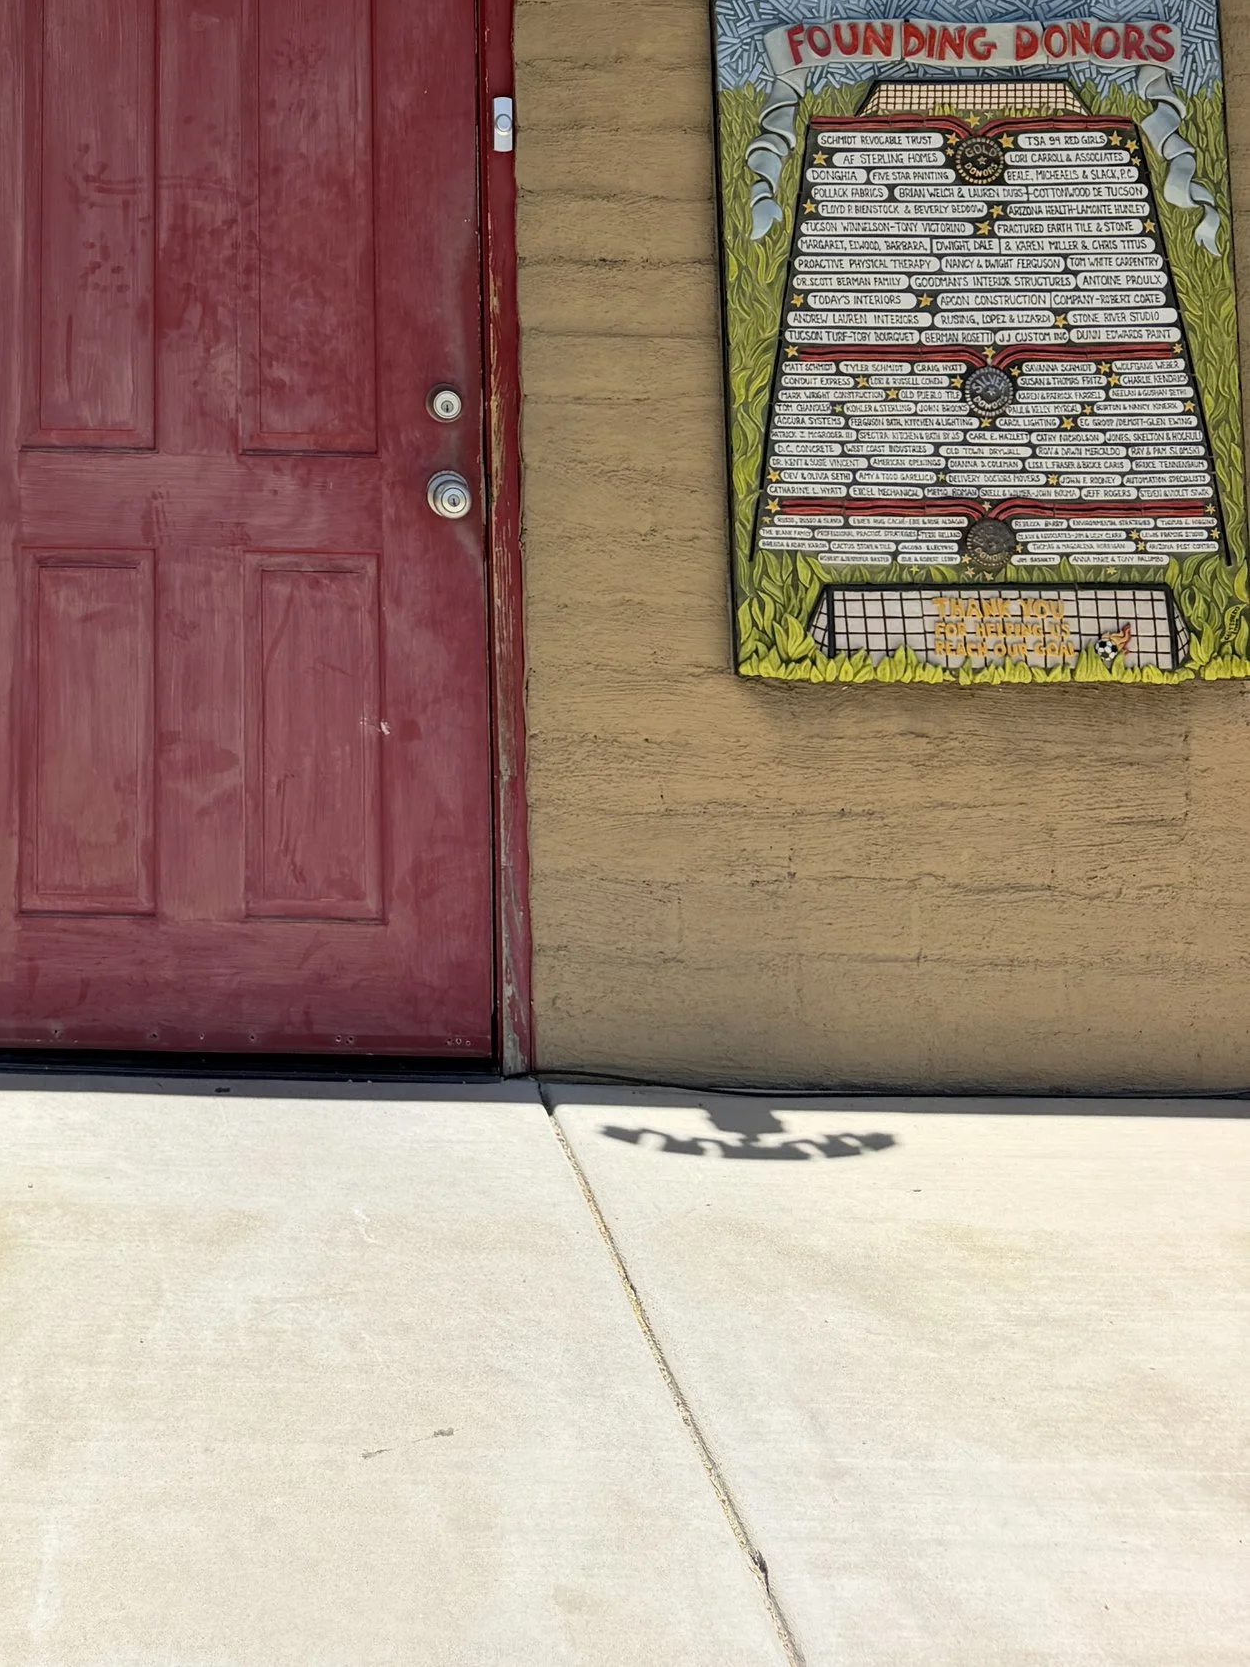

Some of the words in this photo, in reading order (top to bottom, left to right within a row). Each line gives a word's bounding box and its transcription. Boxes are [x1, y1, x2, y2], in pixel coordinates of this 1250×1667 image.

[786, 23, 997, 67] FOUNDING
[1014, 21, 1176, 63] DONORS
[821, 136, 856, 145] SCHMIDT
[861, 136, 902, 144] REVOCABLE
[905, 136, 932, 144] TRUST
[1026, 136, 1046, 145] TSA
[1064, 136, 1079, 144] RED
[1081, 135, 1105, 144] GIRLS
[965, 144, 998, 158] GOLD
[860, 154, 904, 164] STERLING
[908, 153, 938, 163] HOMES
[1010, 154, 1027, 163] LORI
[1031, 154, 1063, 162] CARROLL
[1066, 154, 1072, 162] &
[1074, 153, 1124, 162] ASSOCIATES
[964, 162, 998, 177] DONORS
[812, 171, 857, 181] DONGHIA
[873, 172, 889, 180] FIVE
[892, 172, 911, 180] STAR
[913, 172, 948, 180] PAINTING
[814, 189, 848, 198] POLLACK
[851, 188, 884, 198] FABRICS
[821, 205, 845, 214] FLOYD
[855, 205, 899, 214] BIENSTOCK
[904, 205, 911, 214] &
[914, 205, 948, 213] BEVERLY
[1008, 207, 1042, 215] ARIZONA
[805, 223, 837, 232] TUCSON
[997, 223, 1044, 233] FRACTURED
[1047, 223, 1072, 233] EARTH
[1075, 223, 1093, 232] TILE
[1105, 222, 1133, 232] STONE
[798, 260, 844, 269] PROACTIVE
[850, 260, 888, 269] PHYSICAL
[891, 260, 931, 269] THERAPY
[945, 260, 974, 269] NANCY
[976, 260, 983, 269] &
[1017, 259, 1061, 268] FERGUSON
[1070, 257, 1085, 267] TOM
[1087, 257, 1113, 266] WHITE
[1116, 257, 1159, 266] CARPENTRY
[1014, 277, 1071, 286] STRUCTURES
[1083, 275, 1121, 285] ANTOINE
[1126, 275, 1162, 284] PROULX
[854, 296, 901, 304] INTERIORS
[974, 295, 1046, 306] CONSTRUCTION
[1134, 294, 1160, 303] COATE
[793, 314, 828, 323] ANDREW
[833, 314, 867, 323] LAUREN
[874, 314, 919, 323] INTERIORS
[982, 315, 1006, 323] LOPEZ
[1009, 315, 1015, 323] &
[1073, 313, 1100, 323] STONE
[1104, 313, 1127, 322] RIVER
[1130, 312, 1159, 322] STUDIO
[789, 331, 823, 341] TUCSON
[924, 333, 958, 342] BERMAN
[1014, 332, 1051, 342] CUSTOM
[1077, 330, 1101, 340] DUNN
[1146, 330, 1171, 339] PAINT
[972, 374, 1007, 393] SILVER
[933, 597, 1011, 618] THANK
[1019, 598, 1065, 619] YOU
[934, 621, 966, 636] FOR
[976, 622, 1043, 637] HELPING
[1049, 622, 1070, 636] US
[935, 638, 988, 656] REACH
[994, 641, 1028, 656] OUR
